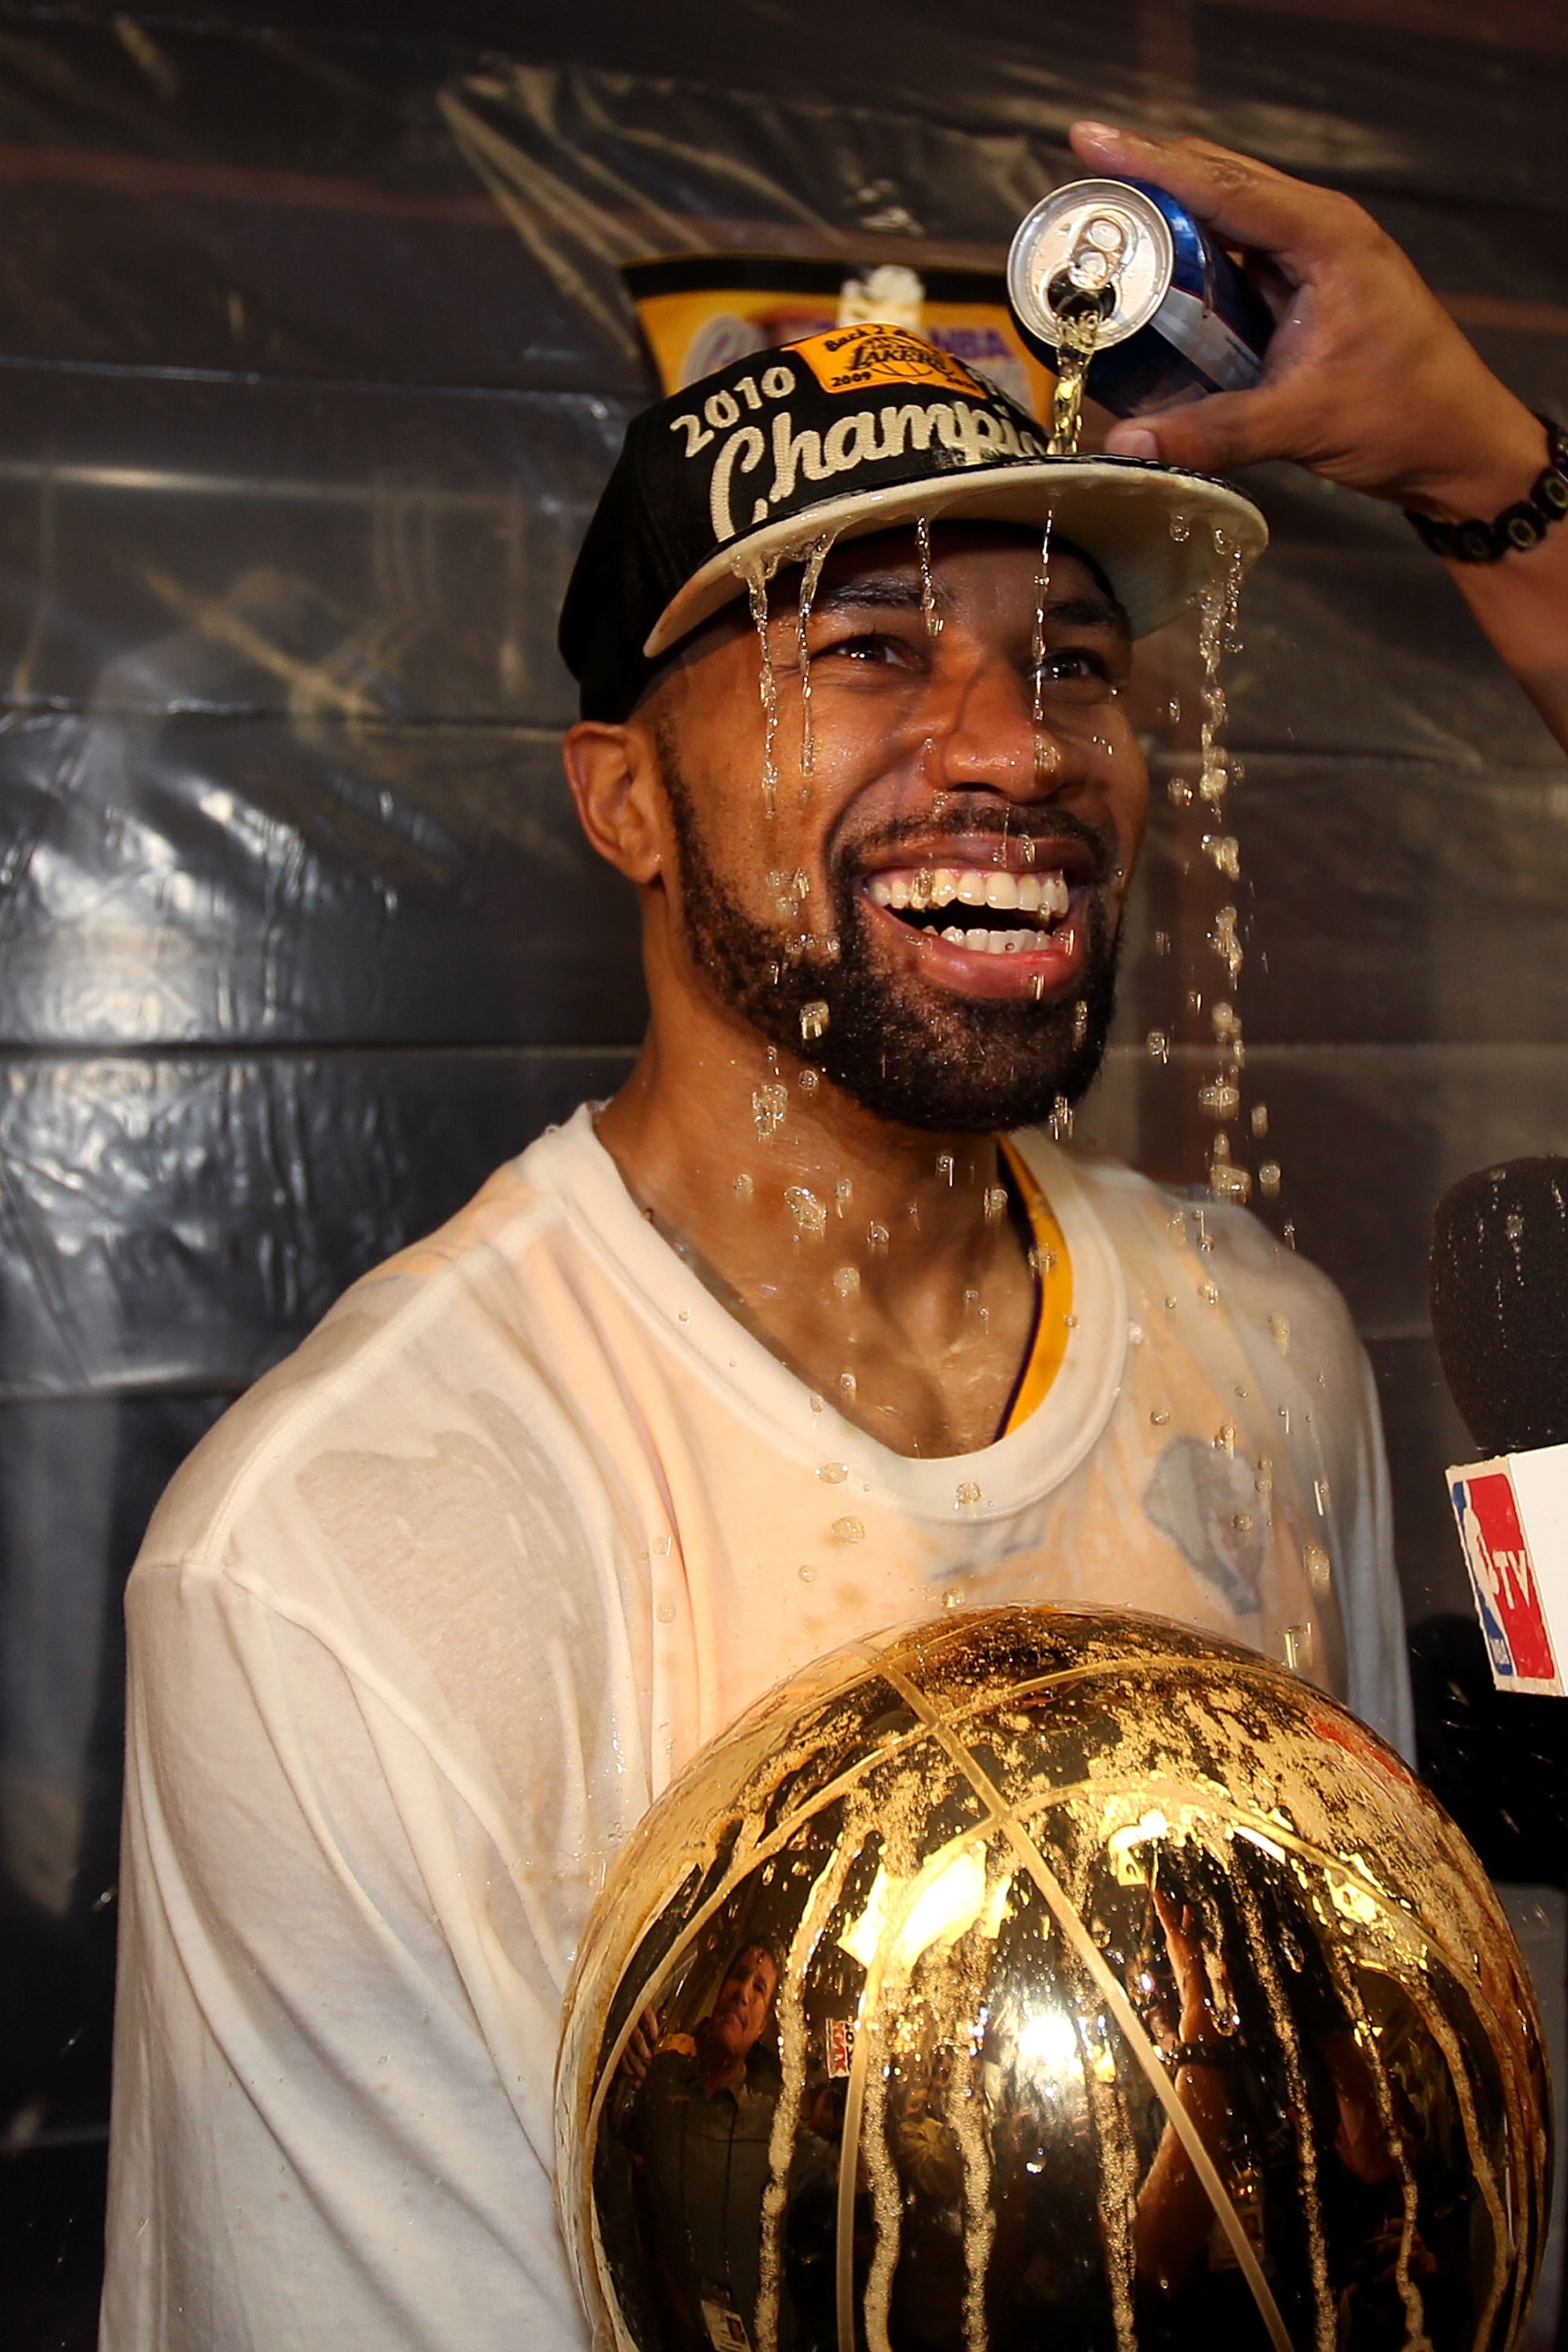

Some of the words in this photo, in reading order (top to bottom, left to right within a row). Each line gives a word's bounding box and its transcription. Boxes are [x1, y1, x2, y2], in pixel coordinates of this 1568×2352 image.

[824, 328, 870, 352] Back
[872, 325, 886, 334] 2
[831, 371, 872, 387] 2009
[671, 366, 796, 458] 2010
[1493, 1550, 1531, 1610] TV
